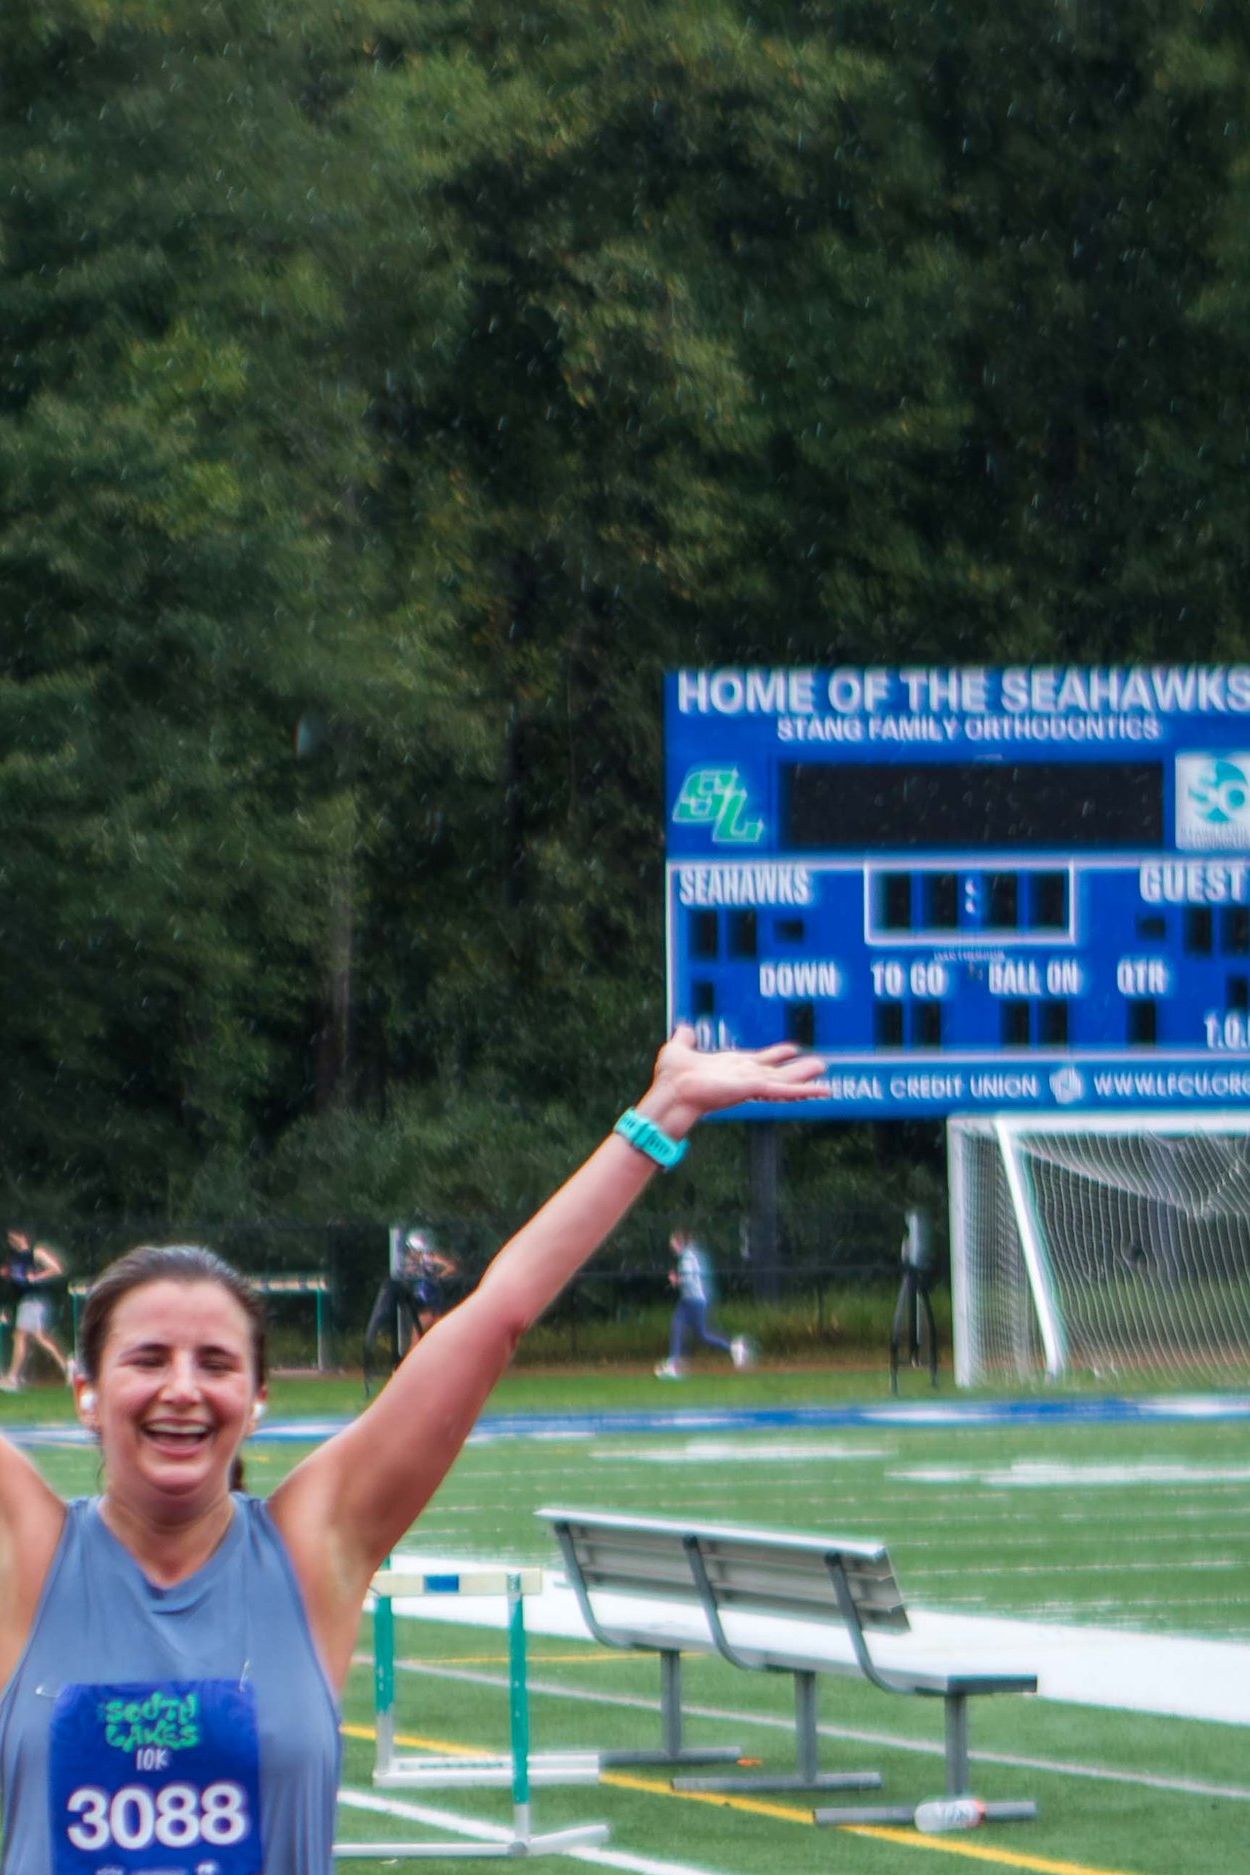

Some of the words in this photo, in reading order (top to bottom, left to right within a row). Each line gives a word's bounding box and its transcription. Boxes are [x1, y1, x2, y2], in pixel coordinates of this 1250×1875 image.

[678, 669, 814, 713] HOME
[828, 669, 886, 713] OF
[900, 668, 986, 712] THE
[1001, 667, 1250, 712] SEAHAWKS
[777, 717, 861, 741] STANG
[868, 716, 957, 741] FAMILY
[965, 715, 1159, 740] ORTHODONTICS
[679, 864, 809, 905] SEAHAWKS
[1140, 859, 1246, 902] GUEST
[759, 960, 836, 996] DOWN
[871, 961, 902, 996] TO
[910, 961, 944, 996] GO
[989, 960, 1041, 995] BALL
[1048, 959, 1078, 995] ON
[1117, 959, 1167, 995] QTR
[890, 1075, 961, 1099] CREDIT
[970, 1074, 1037, 1098] UNION
[135, 1748, 169, 1771] 10K
[67, 1783, 246, 1850] 3088
